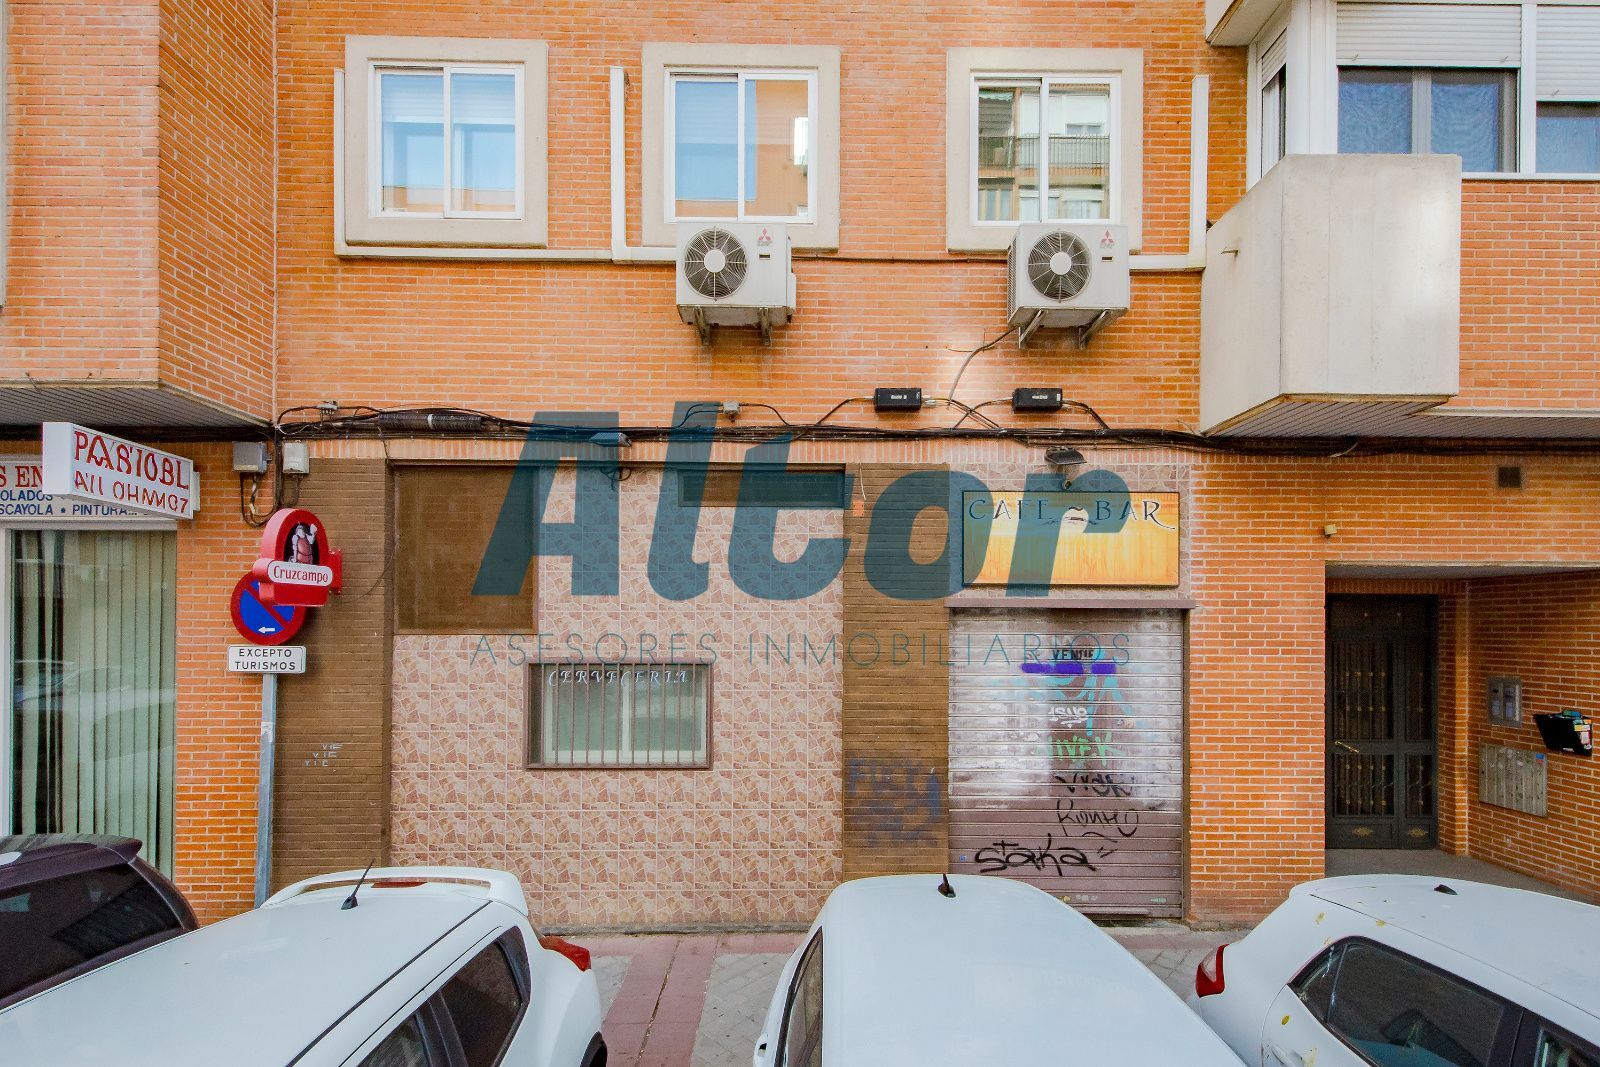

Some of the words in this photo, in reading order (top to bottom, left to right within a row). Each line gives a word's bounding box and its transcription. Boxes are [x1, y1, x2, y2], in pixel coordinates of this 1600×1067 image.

[968, 499, 1053, 521] CAFE
[1095, 500, 1176, 530] BAR
[273, 565, 329, 583] Cruzcampo
[239, 648, 292, 658] EXCEPTO
[235, 661, 296, 671] TURISMOS
[548, 670, 688, 686] CERVECERIA
